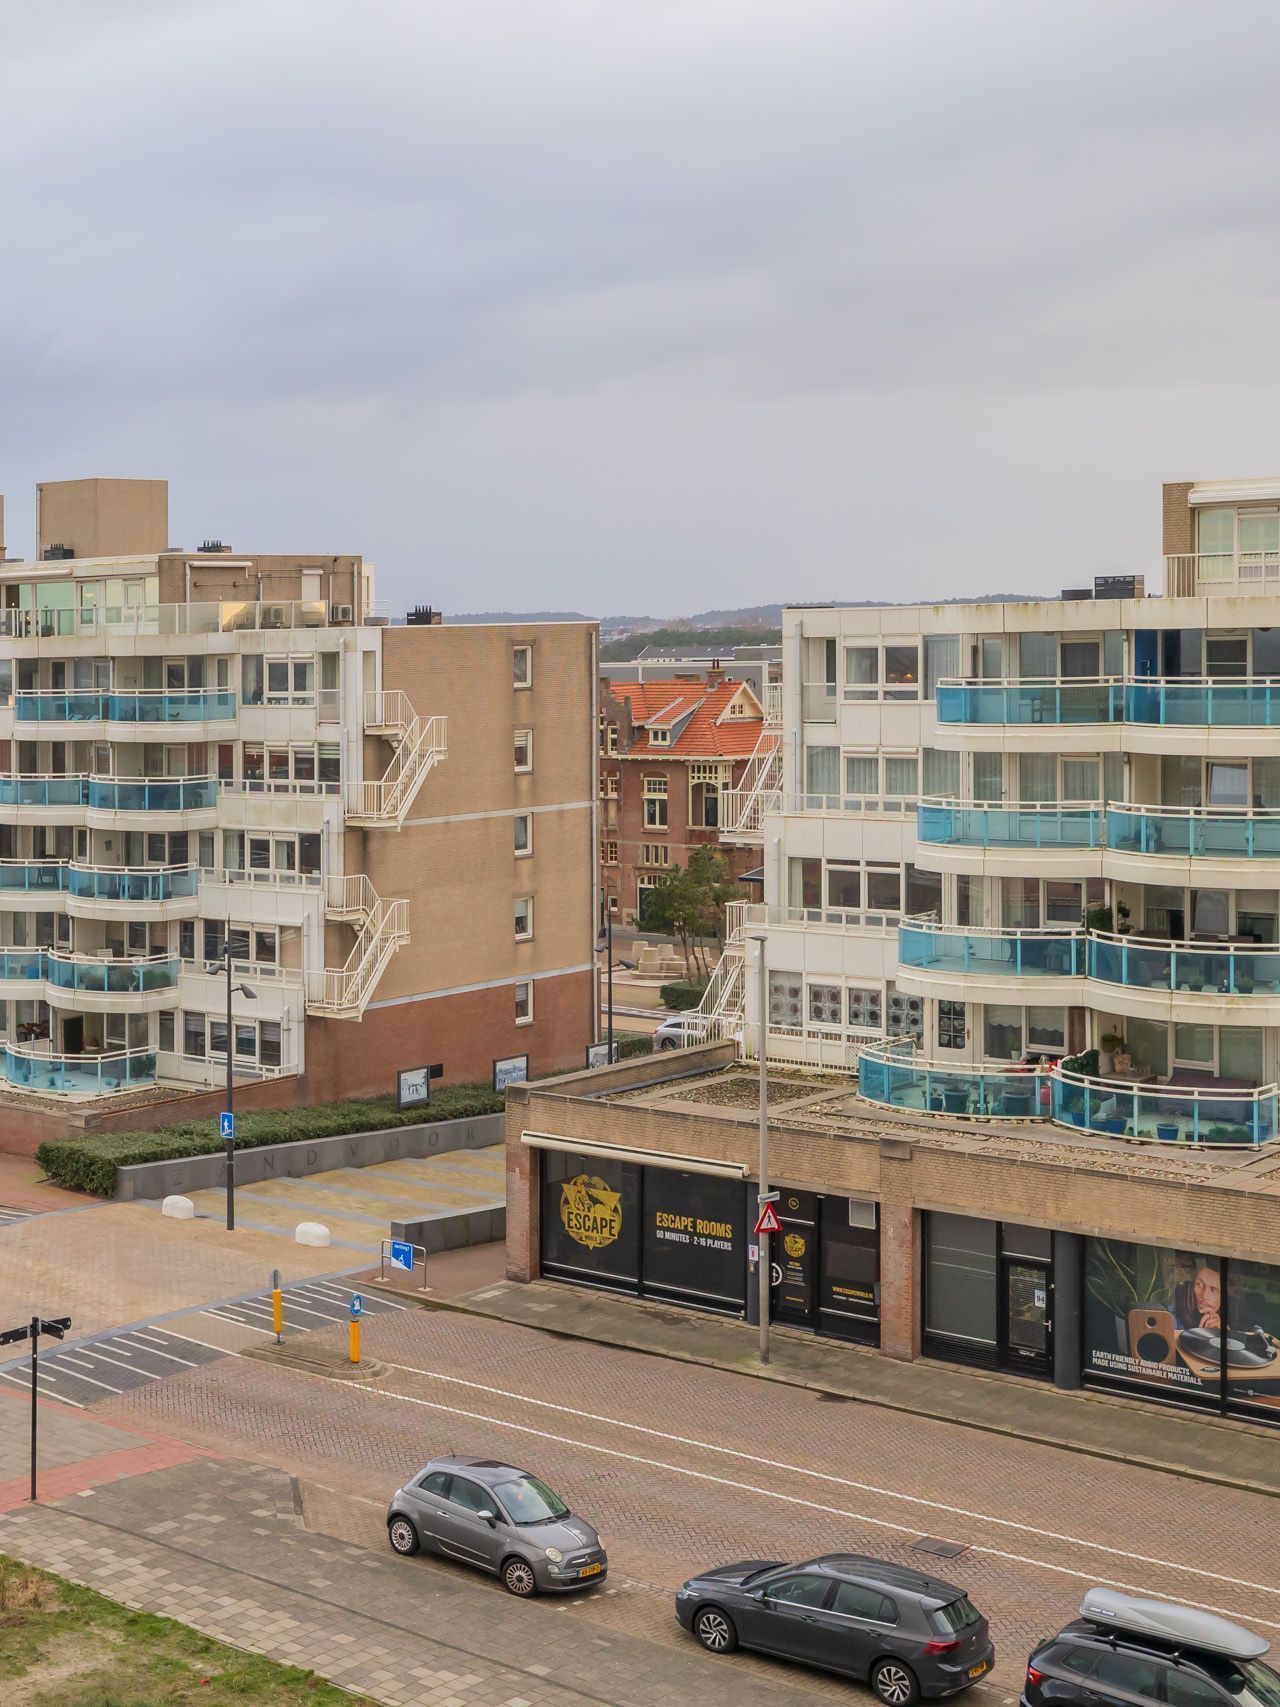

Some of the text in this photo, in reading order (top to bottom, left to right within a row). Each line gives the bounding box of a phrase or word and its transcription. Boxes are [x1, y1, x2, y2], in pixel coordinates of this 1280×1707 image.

[566, 1211, 616, 1237] ESCAPE
[656, 1212, 732, 1238] ESCAPE ROOMS
[656, 1229, 732, 1251] 60 MINUTES 2-16 PLAYERS
[1092, 1350, 1112, 1360] EARTH
[1112, 1353, 1140, 1365] FRIENDLY
[1140, 1360, 1159, 1370] AUDIO
[1159, 1363, 1190, 1376] PRODUCTS
[1092, 1357, 1204, 1385] MADE USING SUSTAINABLE MATERIALS.
